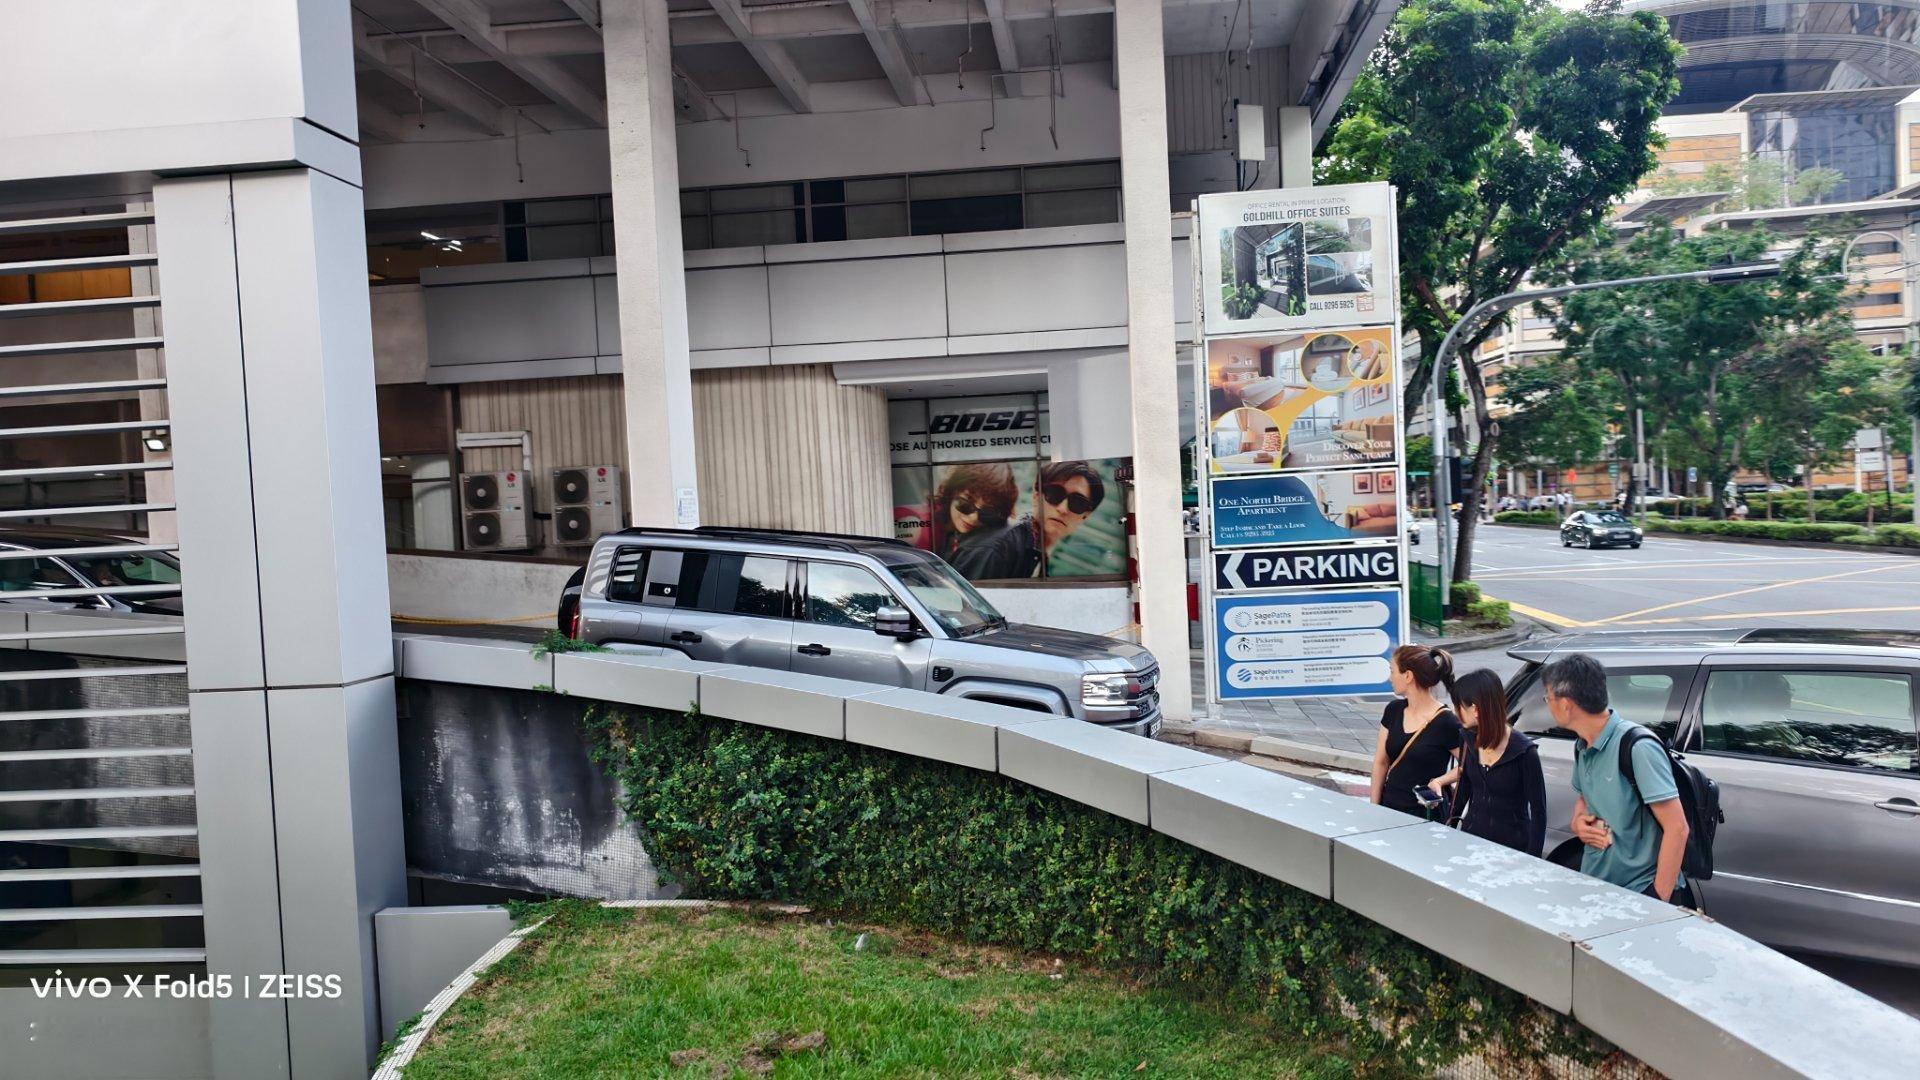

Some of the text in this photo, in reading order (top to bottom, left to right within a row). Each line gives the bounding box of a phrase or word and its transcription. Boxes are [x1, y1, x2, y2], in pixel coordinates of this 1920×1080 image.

[1248, 201, 1267, 209] OFFICE
[1268, 200, 1290, 208] RENTAL
[1318, 197, 1346, 205] LOCATION
[1243, 205, 1351, 222] GOLDHILL OFFICE SUITES
[1309, 302, 1323, 311] CALL
[929, 411, 1037, 434] BOSE
[913, 438, 987, 450] AUTHORIZED
[990, 435, 1037, 447] SERVICE
[1253, 551, 1395, 582] PARKING
[1254, 611, 1292, 620] SagePaths
[1253, 668, 1294, 676] SagePartners
